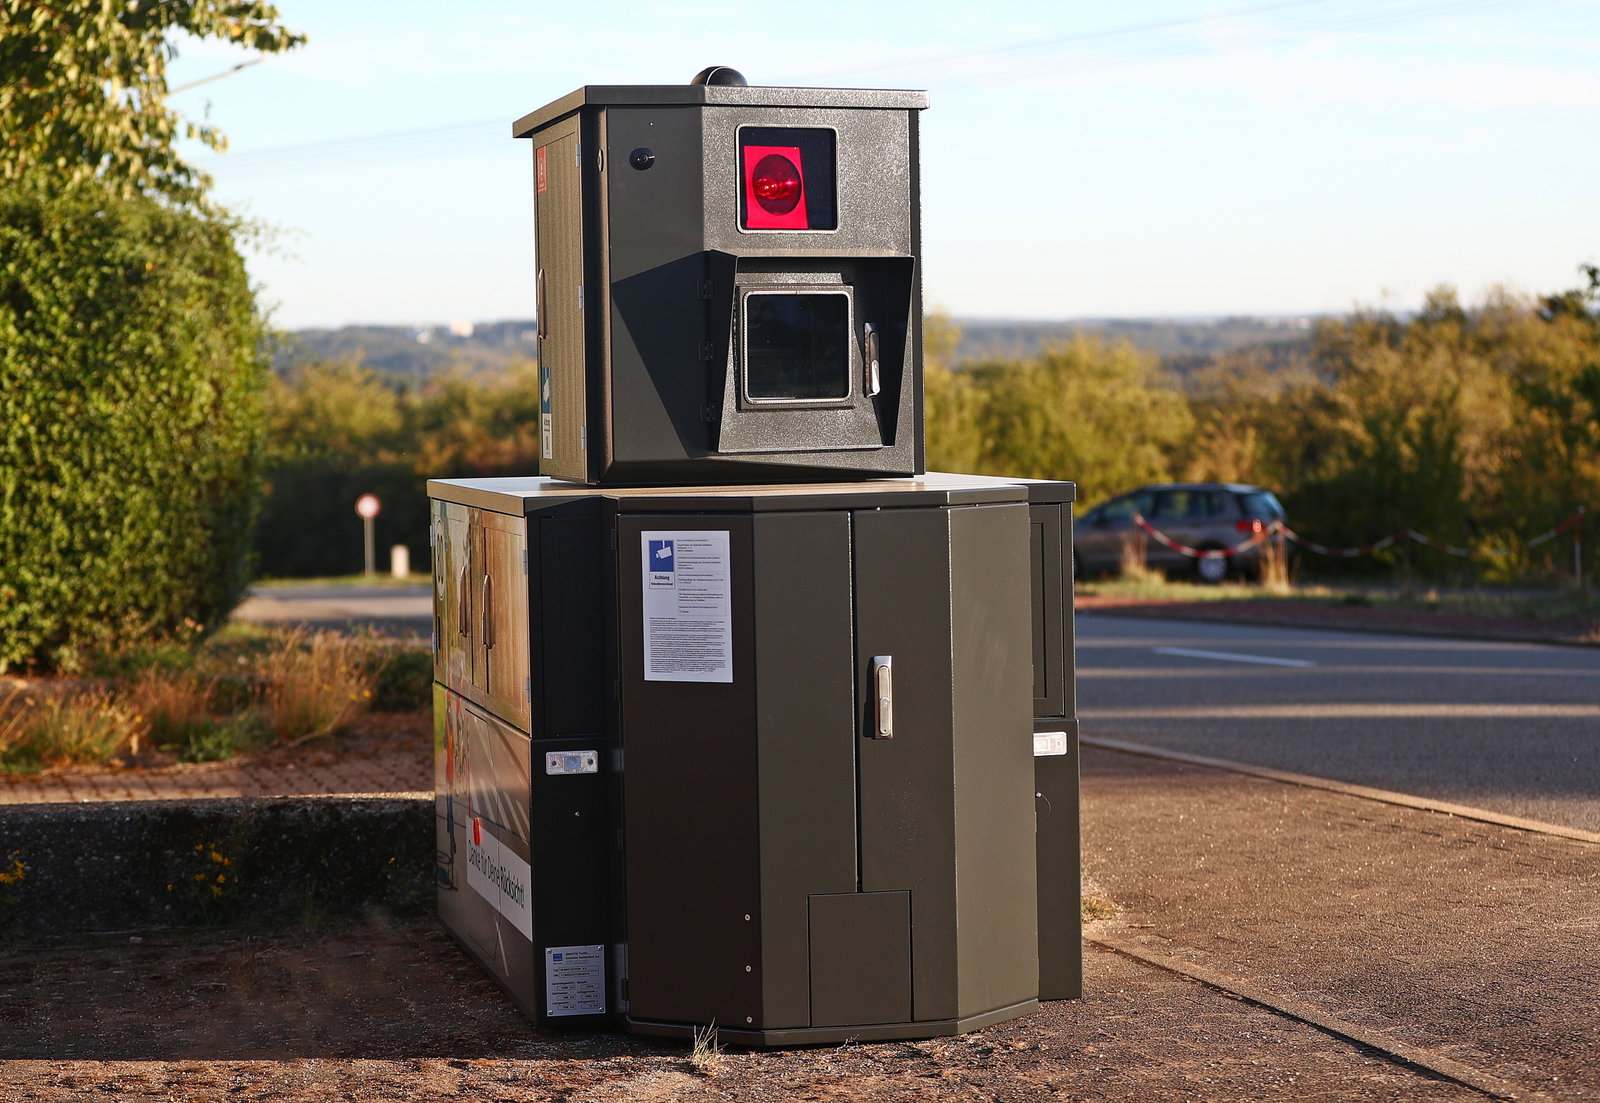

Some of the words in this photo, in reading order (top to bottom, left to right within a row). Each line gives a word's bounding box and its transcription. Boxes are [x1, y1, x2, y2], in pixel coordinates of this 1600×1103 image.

[468, 839, 481, 871] Danke
[487, 856, 500, 887] Deine
[500, 866, 525, 909] Rücksicht!
